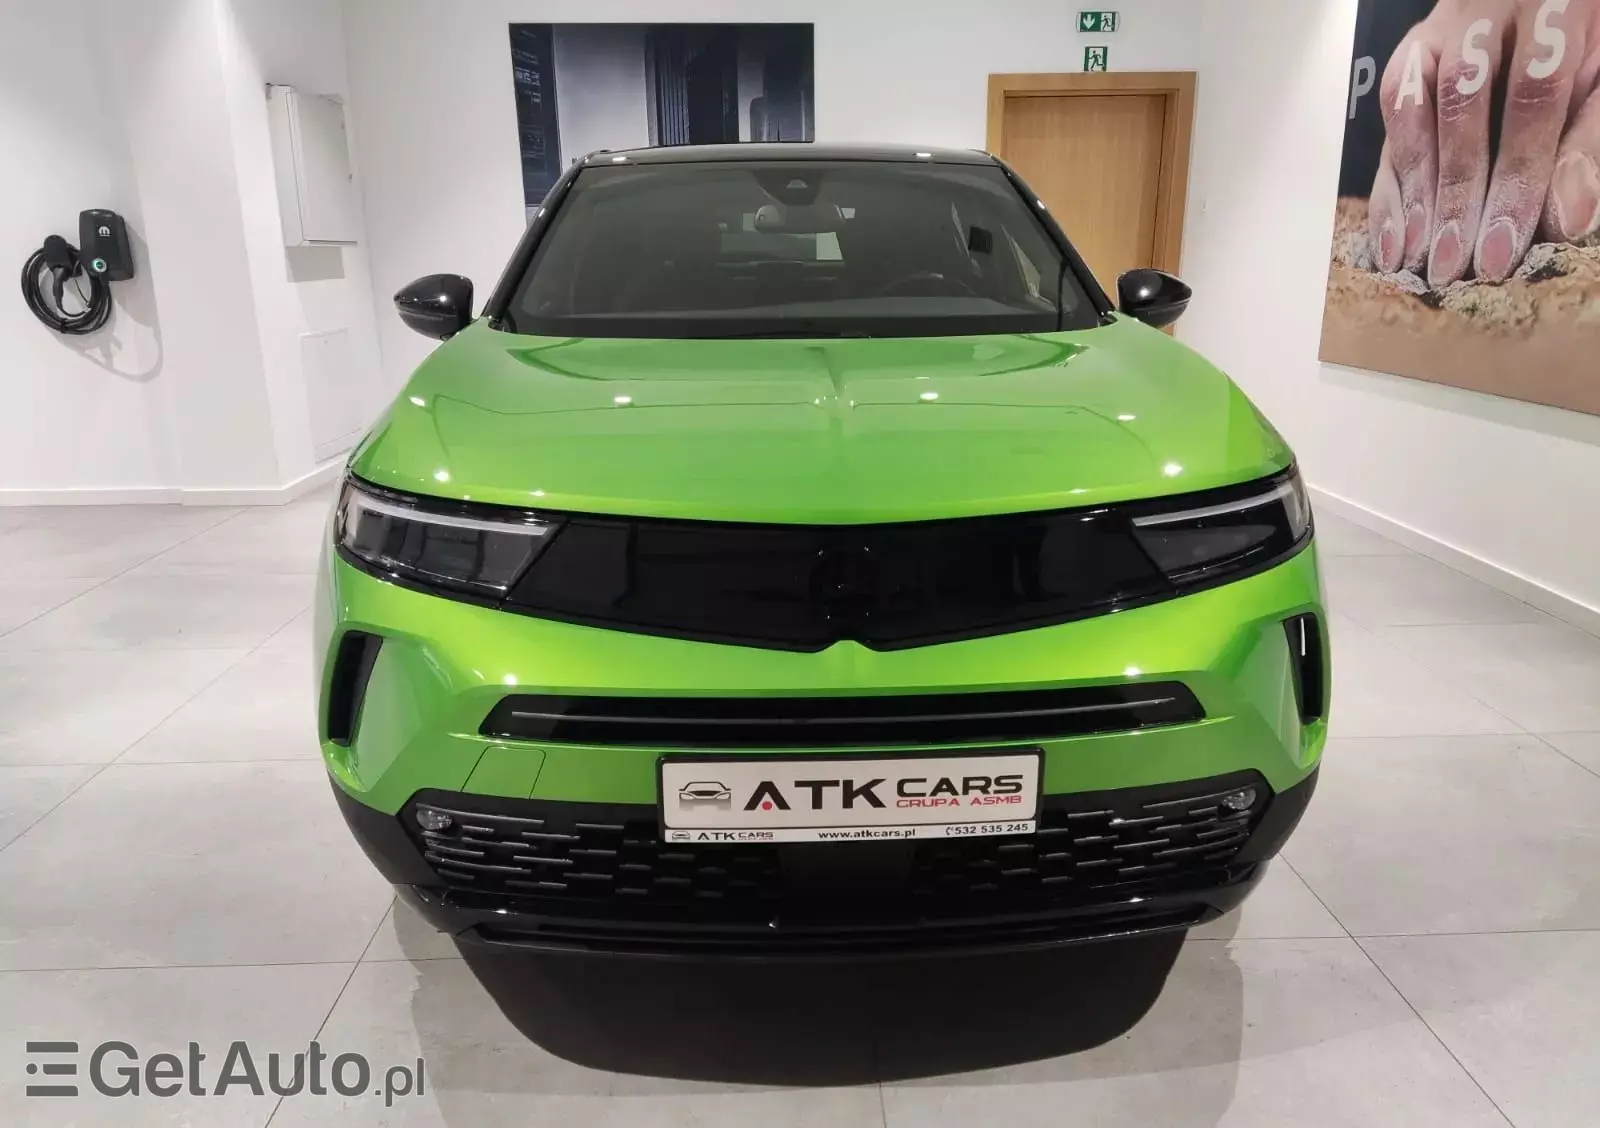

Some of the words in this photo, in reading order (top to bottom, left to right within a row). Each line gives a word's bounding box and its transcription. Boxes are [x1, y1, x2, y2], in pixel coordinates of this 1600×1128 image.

[743, 778, 887, 811] ATK
[897, 775, 1023, 797] CARS
[896, 798, 960, 808] GRUPA
[970, 795, 1022, 806] ASMB
[818, 828, 916, 840] www.atkcars.pl
[981, 824, 1003, 834] 535
[1006, 823, 1029, 832] 245
[697, 832, 736, 840] ATK
